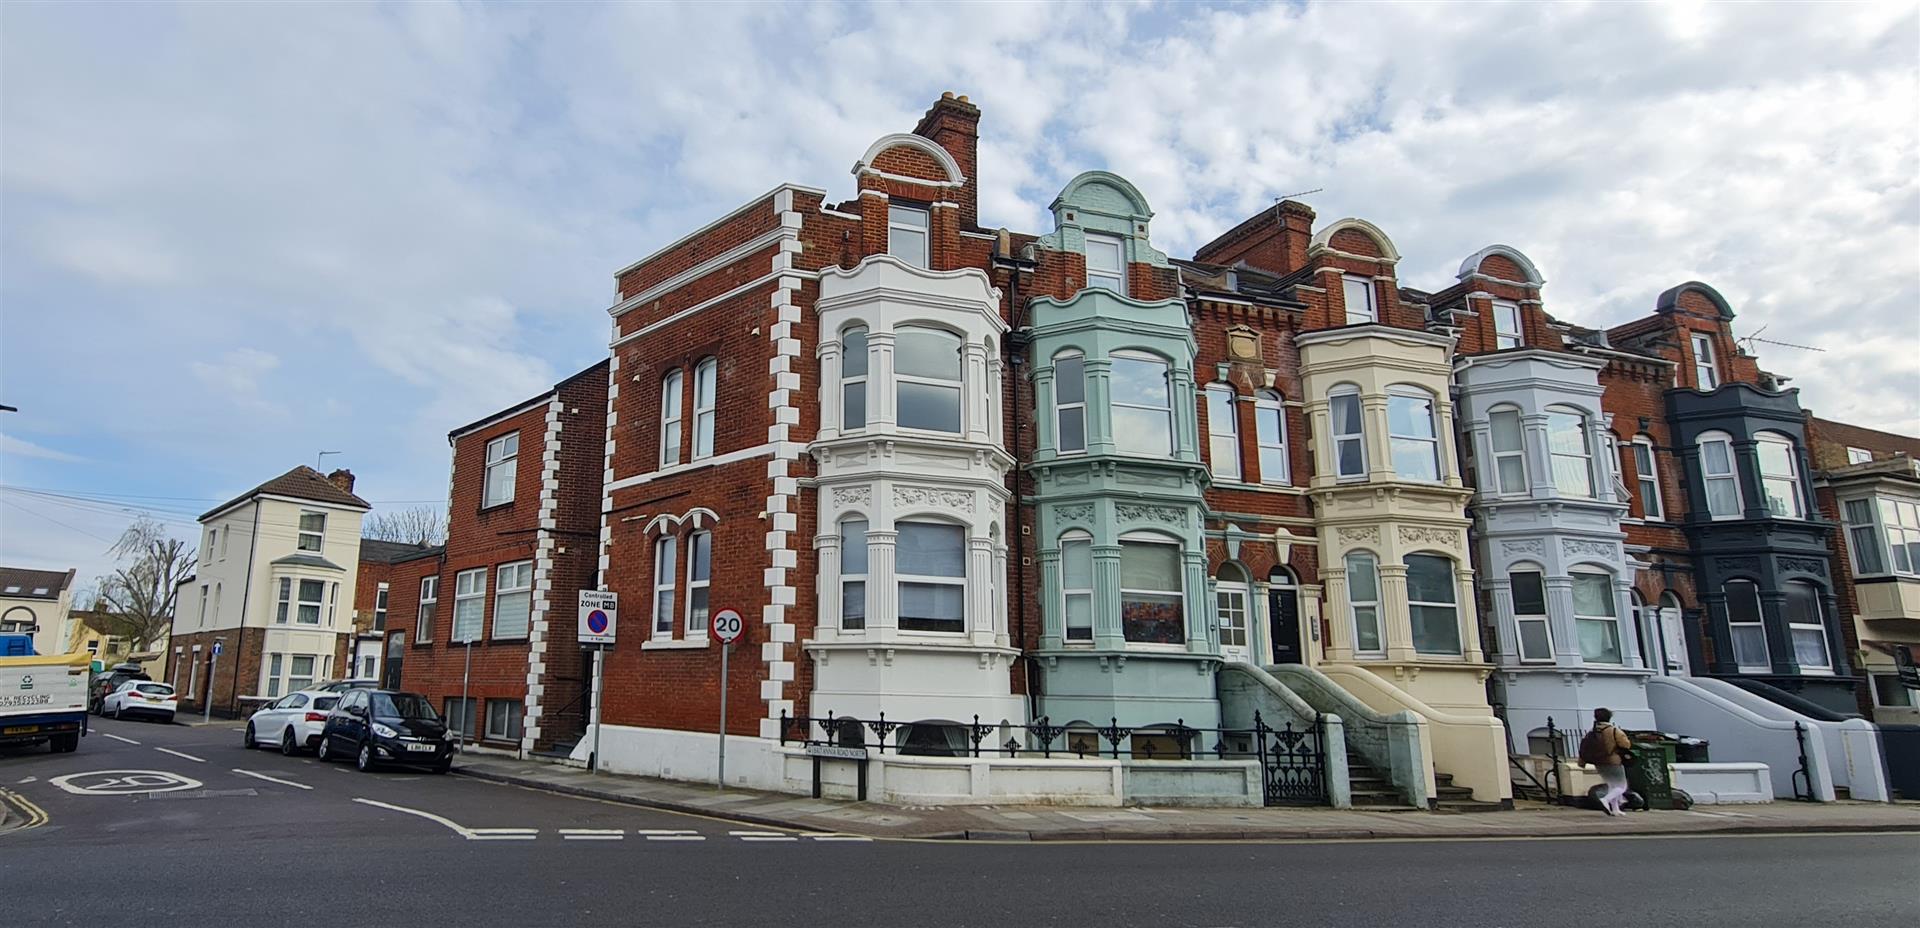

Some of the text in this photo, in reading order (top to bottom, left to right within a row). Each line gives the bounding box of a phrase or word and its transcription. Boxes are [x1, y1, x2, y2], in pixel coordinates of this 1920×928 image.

[584, 592, 613, 600] Controlled
[580, 600, 601, 608] ZONE
[716, 617, 740, 632] 20
